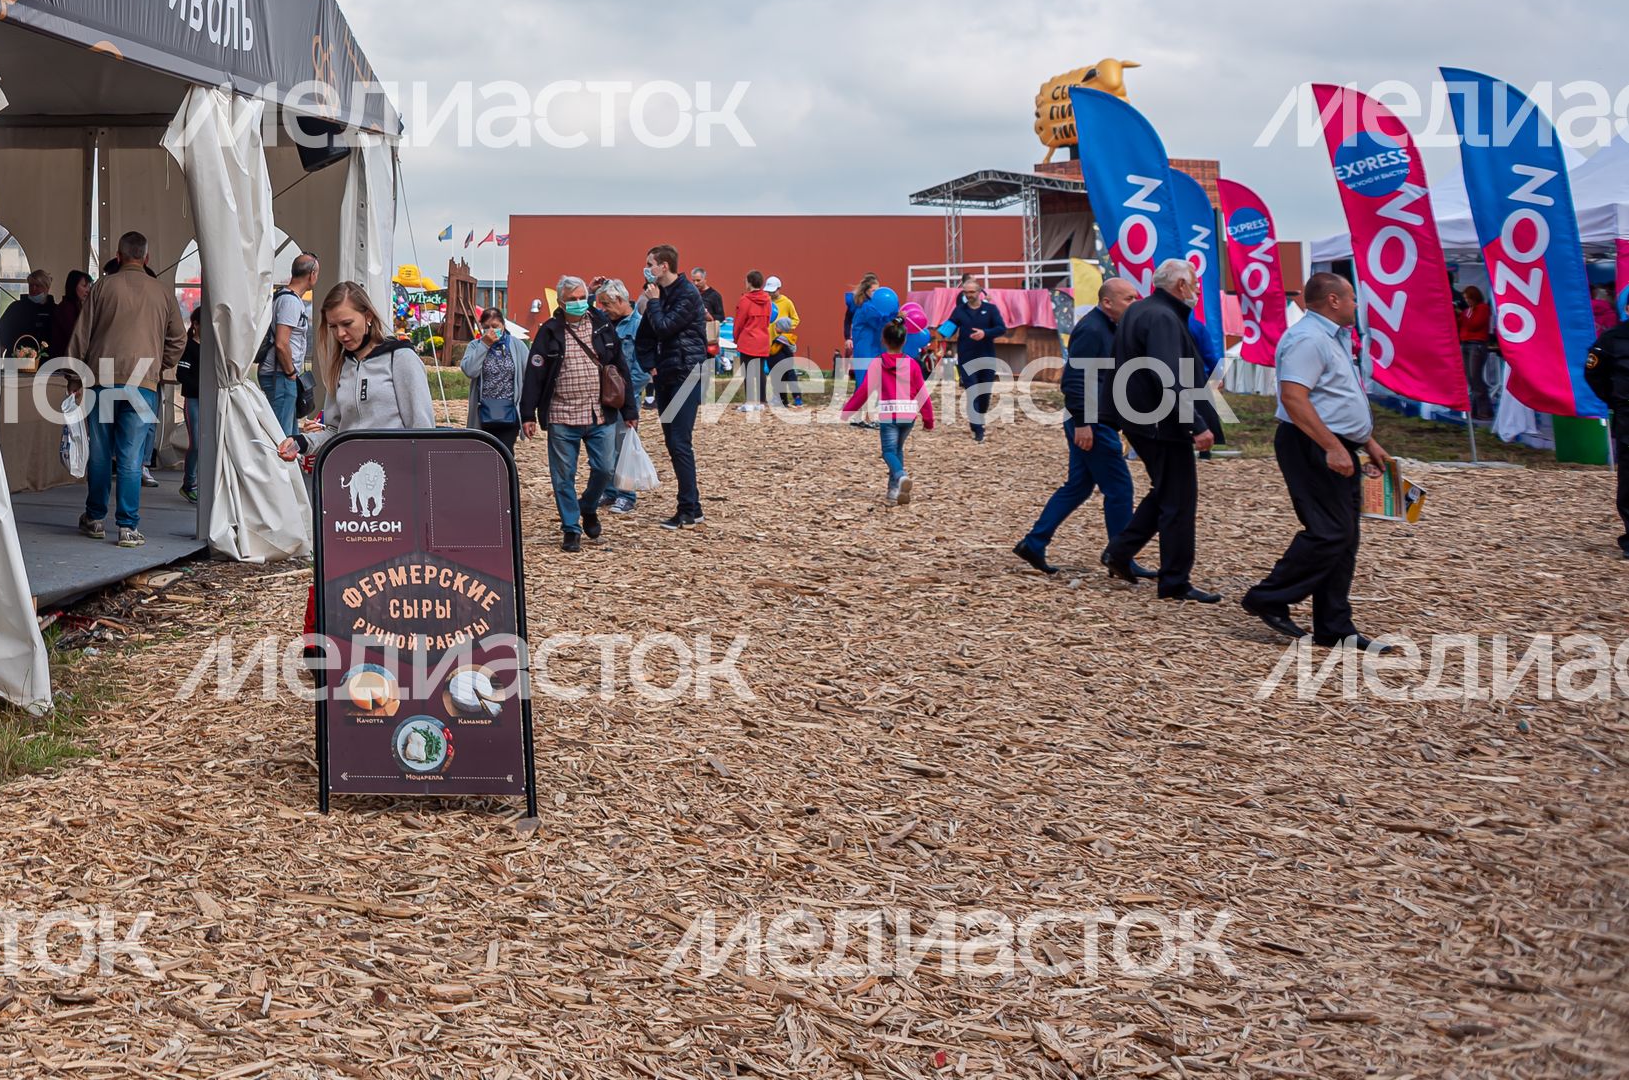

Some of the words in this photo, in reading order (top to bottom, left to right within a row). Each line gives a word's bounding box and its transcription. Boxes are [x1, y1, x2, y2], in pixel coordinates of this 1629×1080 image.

[1052, 84, 1080, 100] СЫ
[1050, 104, 1073, 120] ПИ
[1334, 149, 1411, 181] EXPRESS
[1118, 174, 1163, 299] ZON
[1227, 217, 1269, 237] EXPRESS
[1494, 164, 1558, 343] OZON
[335, 520, 402, 533] МОЛЕОН
[342, 565, 500, 612] ФЕРМЕРСКИЕ
[389, 599, 451, 619] СЫРЫ
[353, 617, 418, 651] РУЧНОЙ
[426, 618, 490, 651] РАБОТЫ
